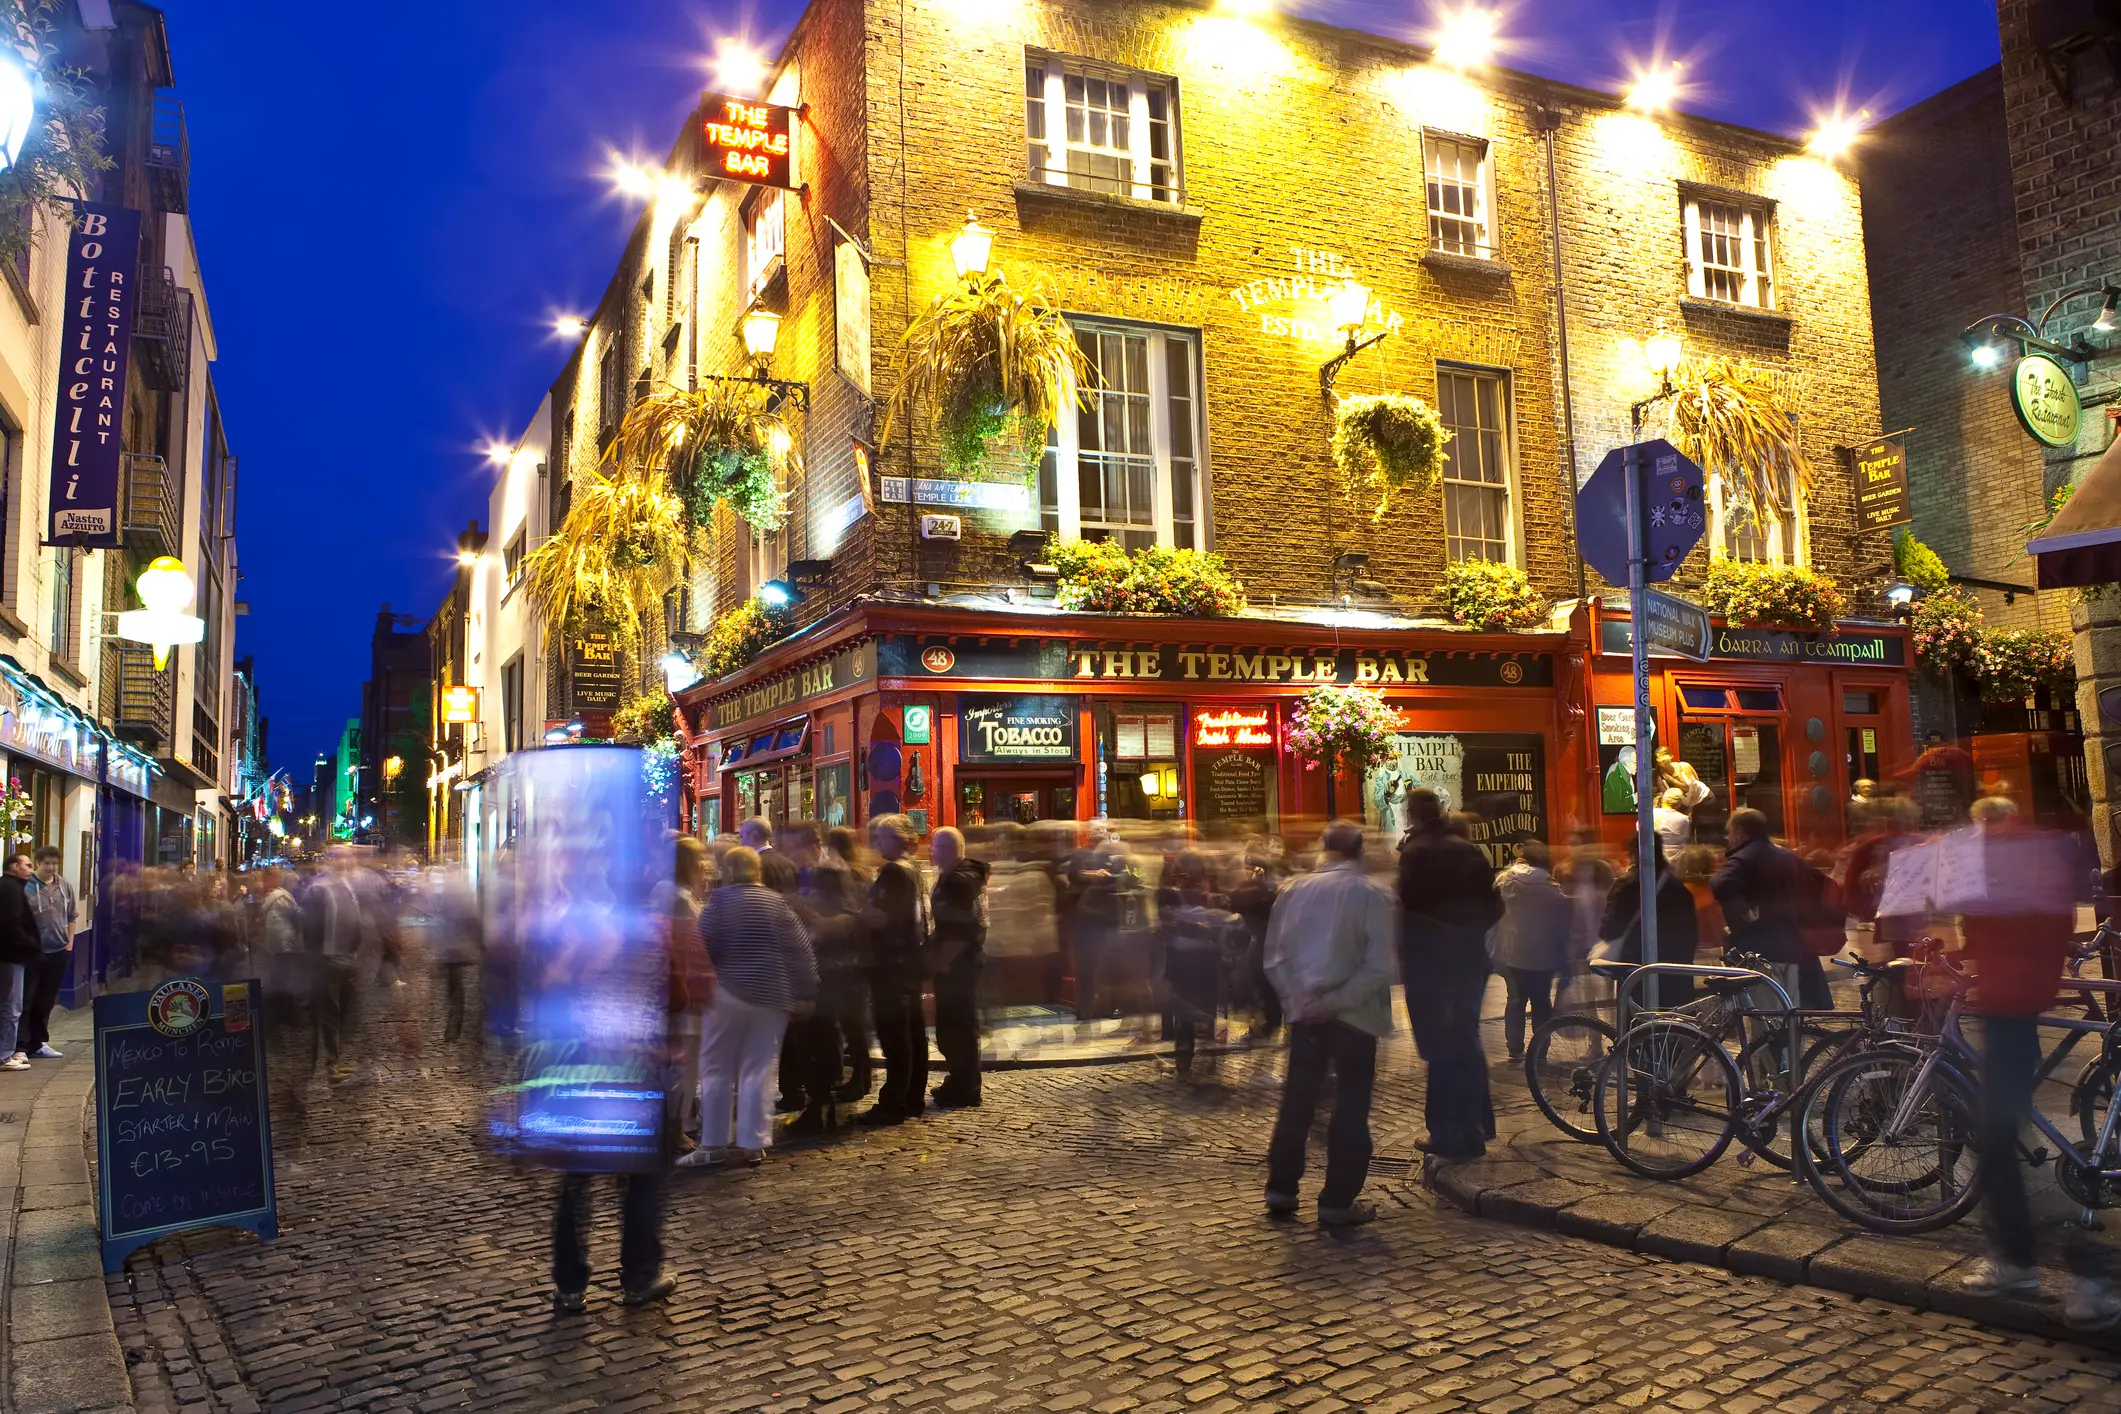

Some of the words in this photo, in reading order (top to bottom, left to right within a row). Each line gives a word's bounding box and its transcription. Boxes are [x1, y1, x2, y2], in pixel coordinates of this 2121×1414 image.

[726, 102, 768, 129] THE
[706, 123, 788, 156] TEMPLE
[726, 151, 769, 178] BAR
[1289, 247, 1344, 275] THE
[1364, 299, 1405, 337] AR
[66, 212, 107, 501] Botticelli
[97, 271, 124, 445] RESTAURANT
[1870, 445, 1885, 456] THE
[1858, 455, 1901, 474] TEMPLE
[1868, 469, 1891, 483] BAR
[934, 481, 945, 492] AN
[1861, 493, 1877, 503] BEER
[1877, 486, 1902, 499] GARDEN
[913, 492, 947, 503] TEMPLE
[67, 513, 104, 525] Nastro
[1866, 509, 1880, 519] LIVE
[1881, 505, 1900, 516] MUSIC
[1875, 513, 1893, 524] DAILY
[61, 520, 105, 532] Azzurro
[1647, 598, 1681, 623] NATIONAL
[1681, 611, 1696, 628] WAX
[1647, 619, 1677, 642] MUSEUM
[1678, 630, 1695, 648] PLUS
[584, 648, 611, 660] BAR
[926, 648, 948, 668] 48
[1070, 650, 1163, 679] THE
[1178, 652, 1338, 682] TEMPLE
[1354, 657, 1430, 684] BAR
[1503, 664, 1518, 680] 48
[717, 698, 742, 726] THE
[744, 677, 796, 717] TEMPLE
[801, 663, 834, 697] BAR
[964, 701, 1013, 721] Importers
[1600, 711, 1616, 721] Beer
[1007, 717, 1025, 725] FINE
[1026, 717, 1062, 725] SMOKING
[1607, 733, 1625, 743] Area
[995, 746, 1029, 755] Always
[1032, 746, 1041, 754] in
[1044, 746, 1070, 755] Stock
[1211, 754, 1244, 770] TEMPLE
[1245, 757, 1261, 771] BAR
[1415, 757, 1447, 772] BAR
[1507, 753, 1533, 771] THE
[1476, 773, 1533, 791] EMPEROR
[1519, 794, 1533, 811] OF
[1491, 812, 1539, 834] LIQUORS
[152, 982, 208, 1008] PAULANER
[112, 1072, 192, 1111] EARLY
[116, 1112, 191, 1144] STARTER
